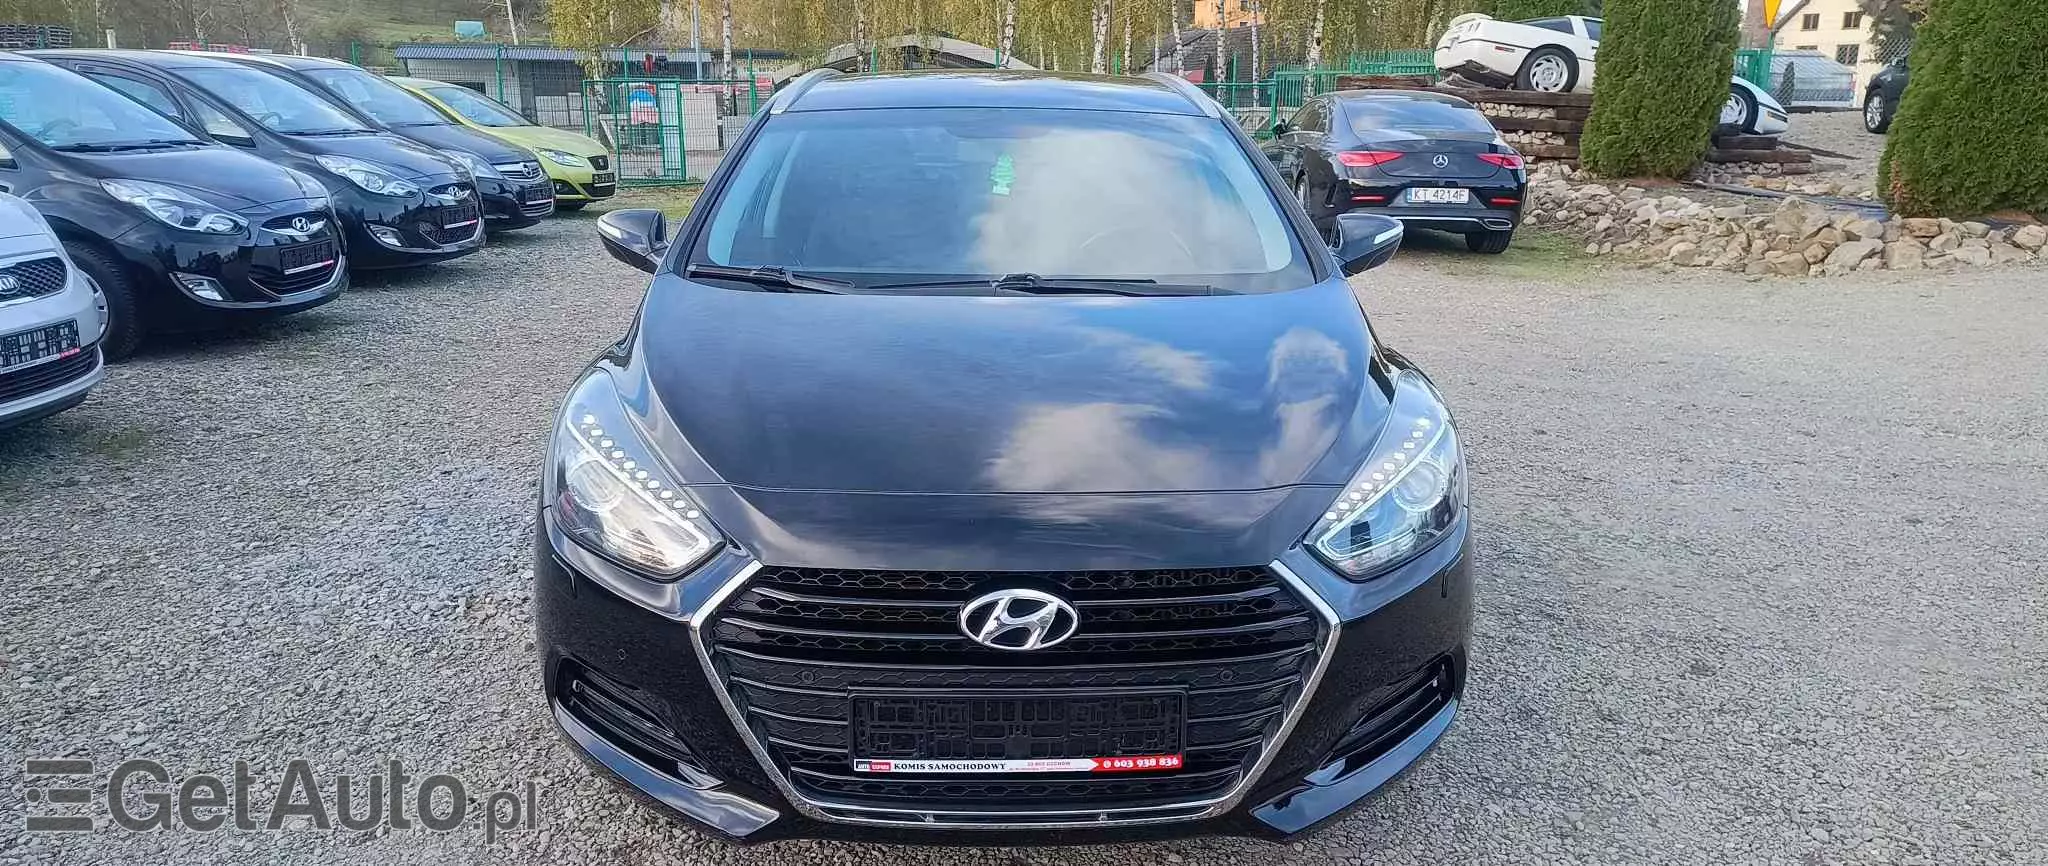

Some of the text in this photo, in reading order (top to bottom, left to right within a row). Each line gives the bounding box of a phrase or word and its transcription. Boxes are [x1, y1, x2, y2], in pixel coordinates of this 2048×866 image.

[1414, 189, 1466, 201] KT 4214F
[1113, 757, 1179, 768] 603 938 836
